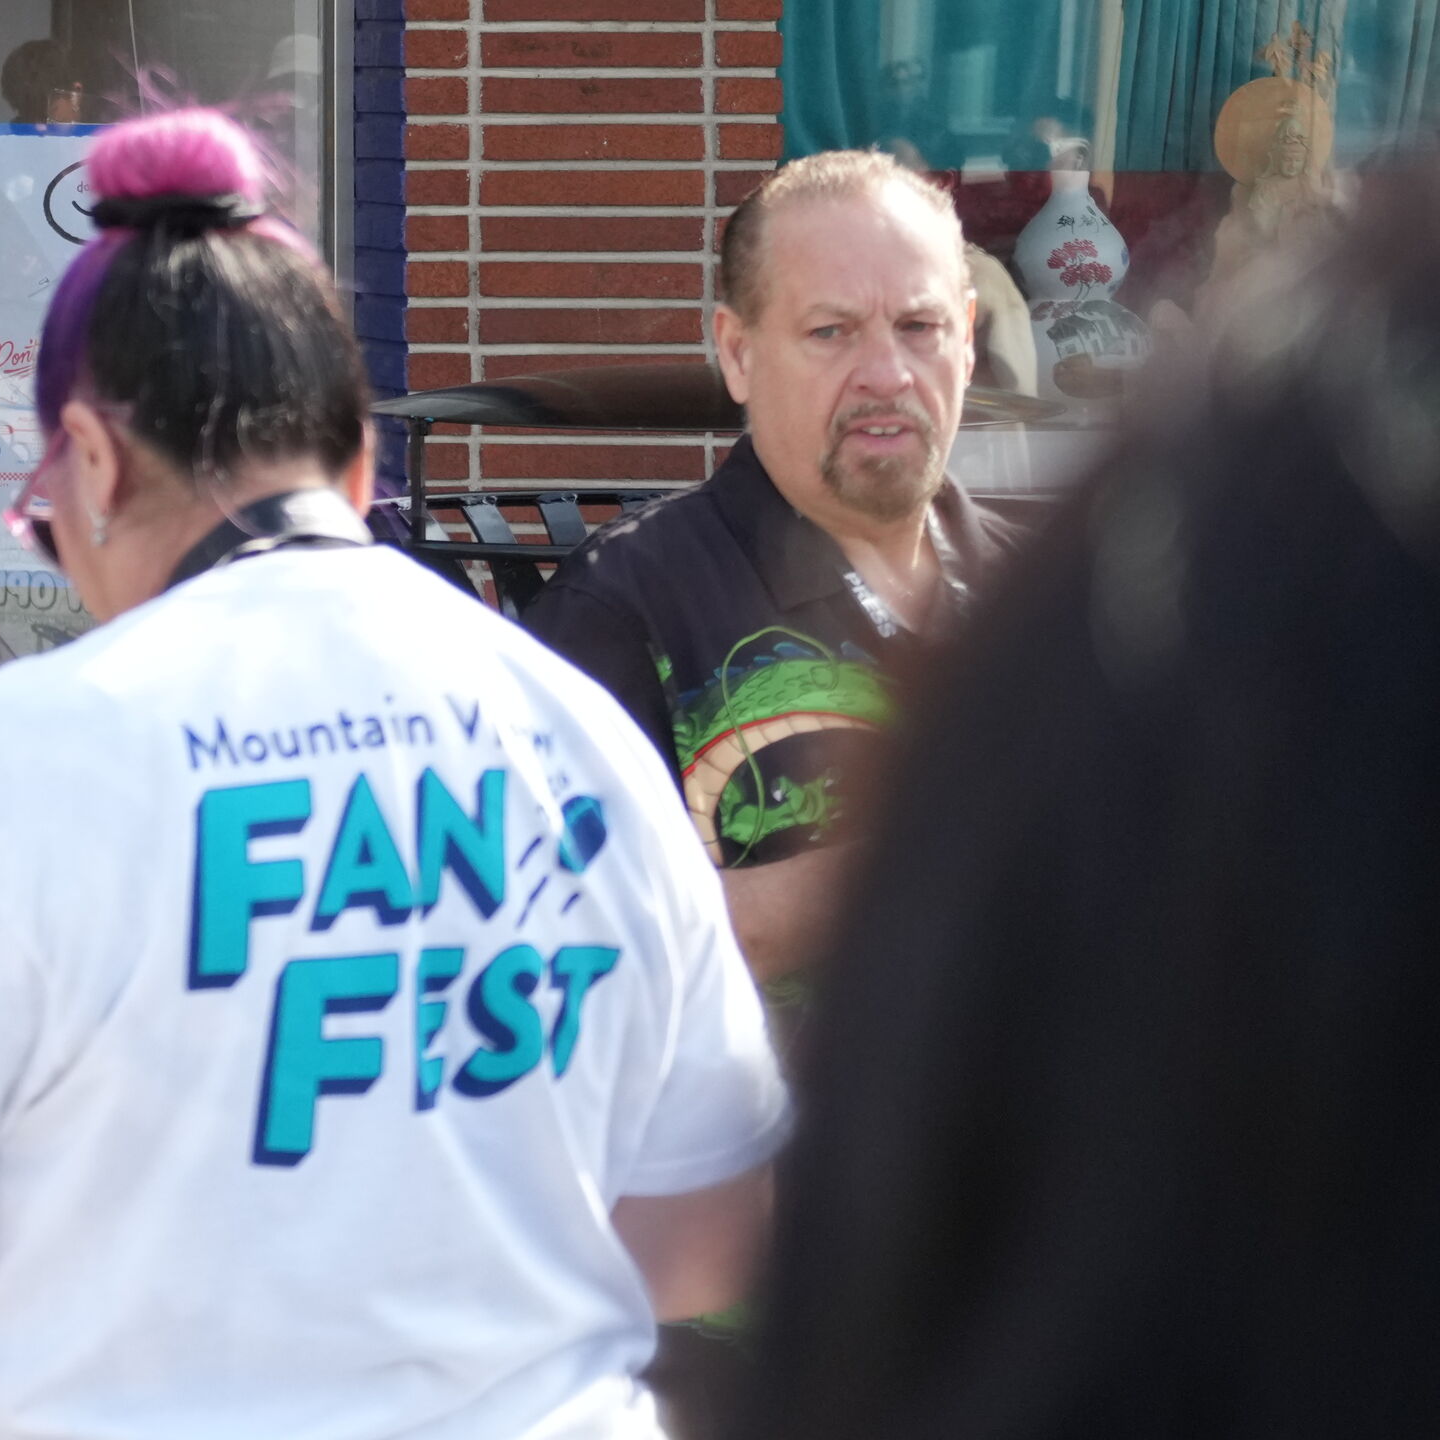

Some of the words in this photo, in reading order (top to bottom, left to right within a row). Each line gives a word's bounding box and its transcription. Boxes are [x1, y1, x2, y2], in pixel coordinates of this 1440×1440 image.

[182, 692, 434, 771] Mountain
[188, 765, 507, 991] FAN
[250, 943, 623, 1168] FEST
